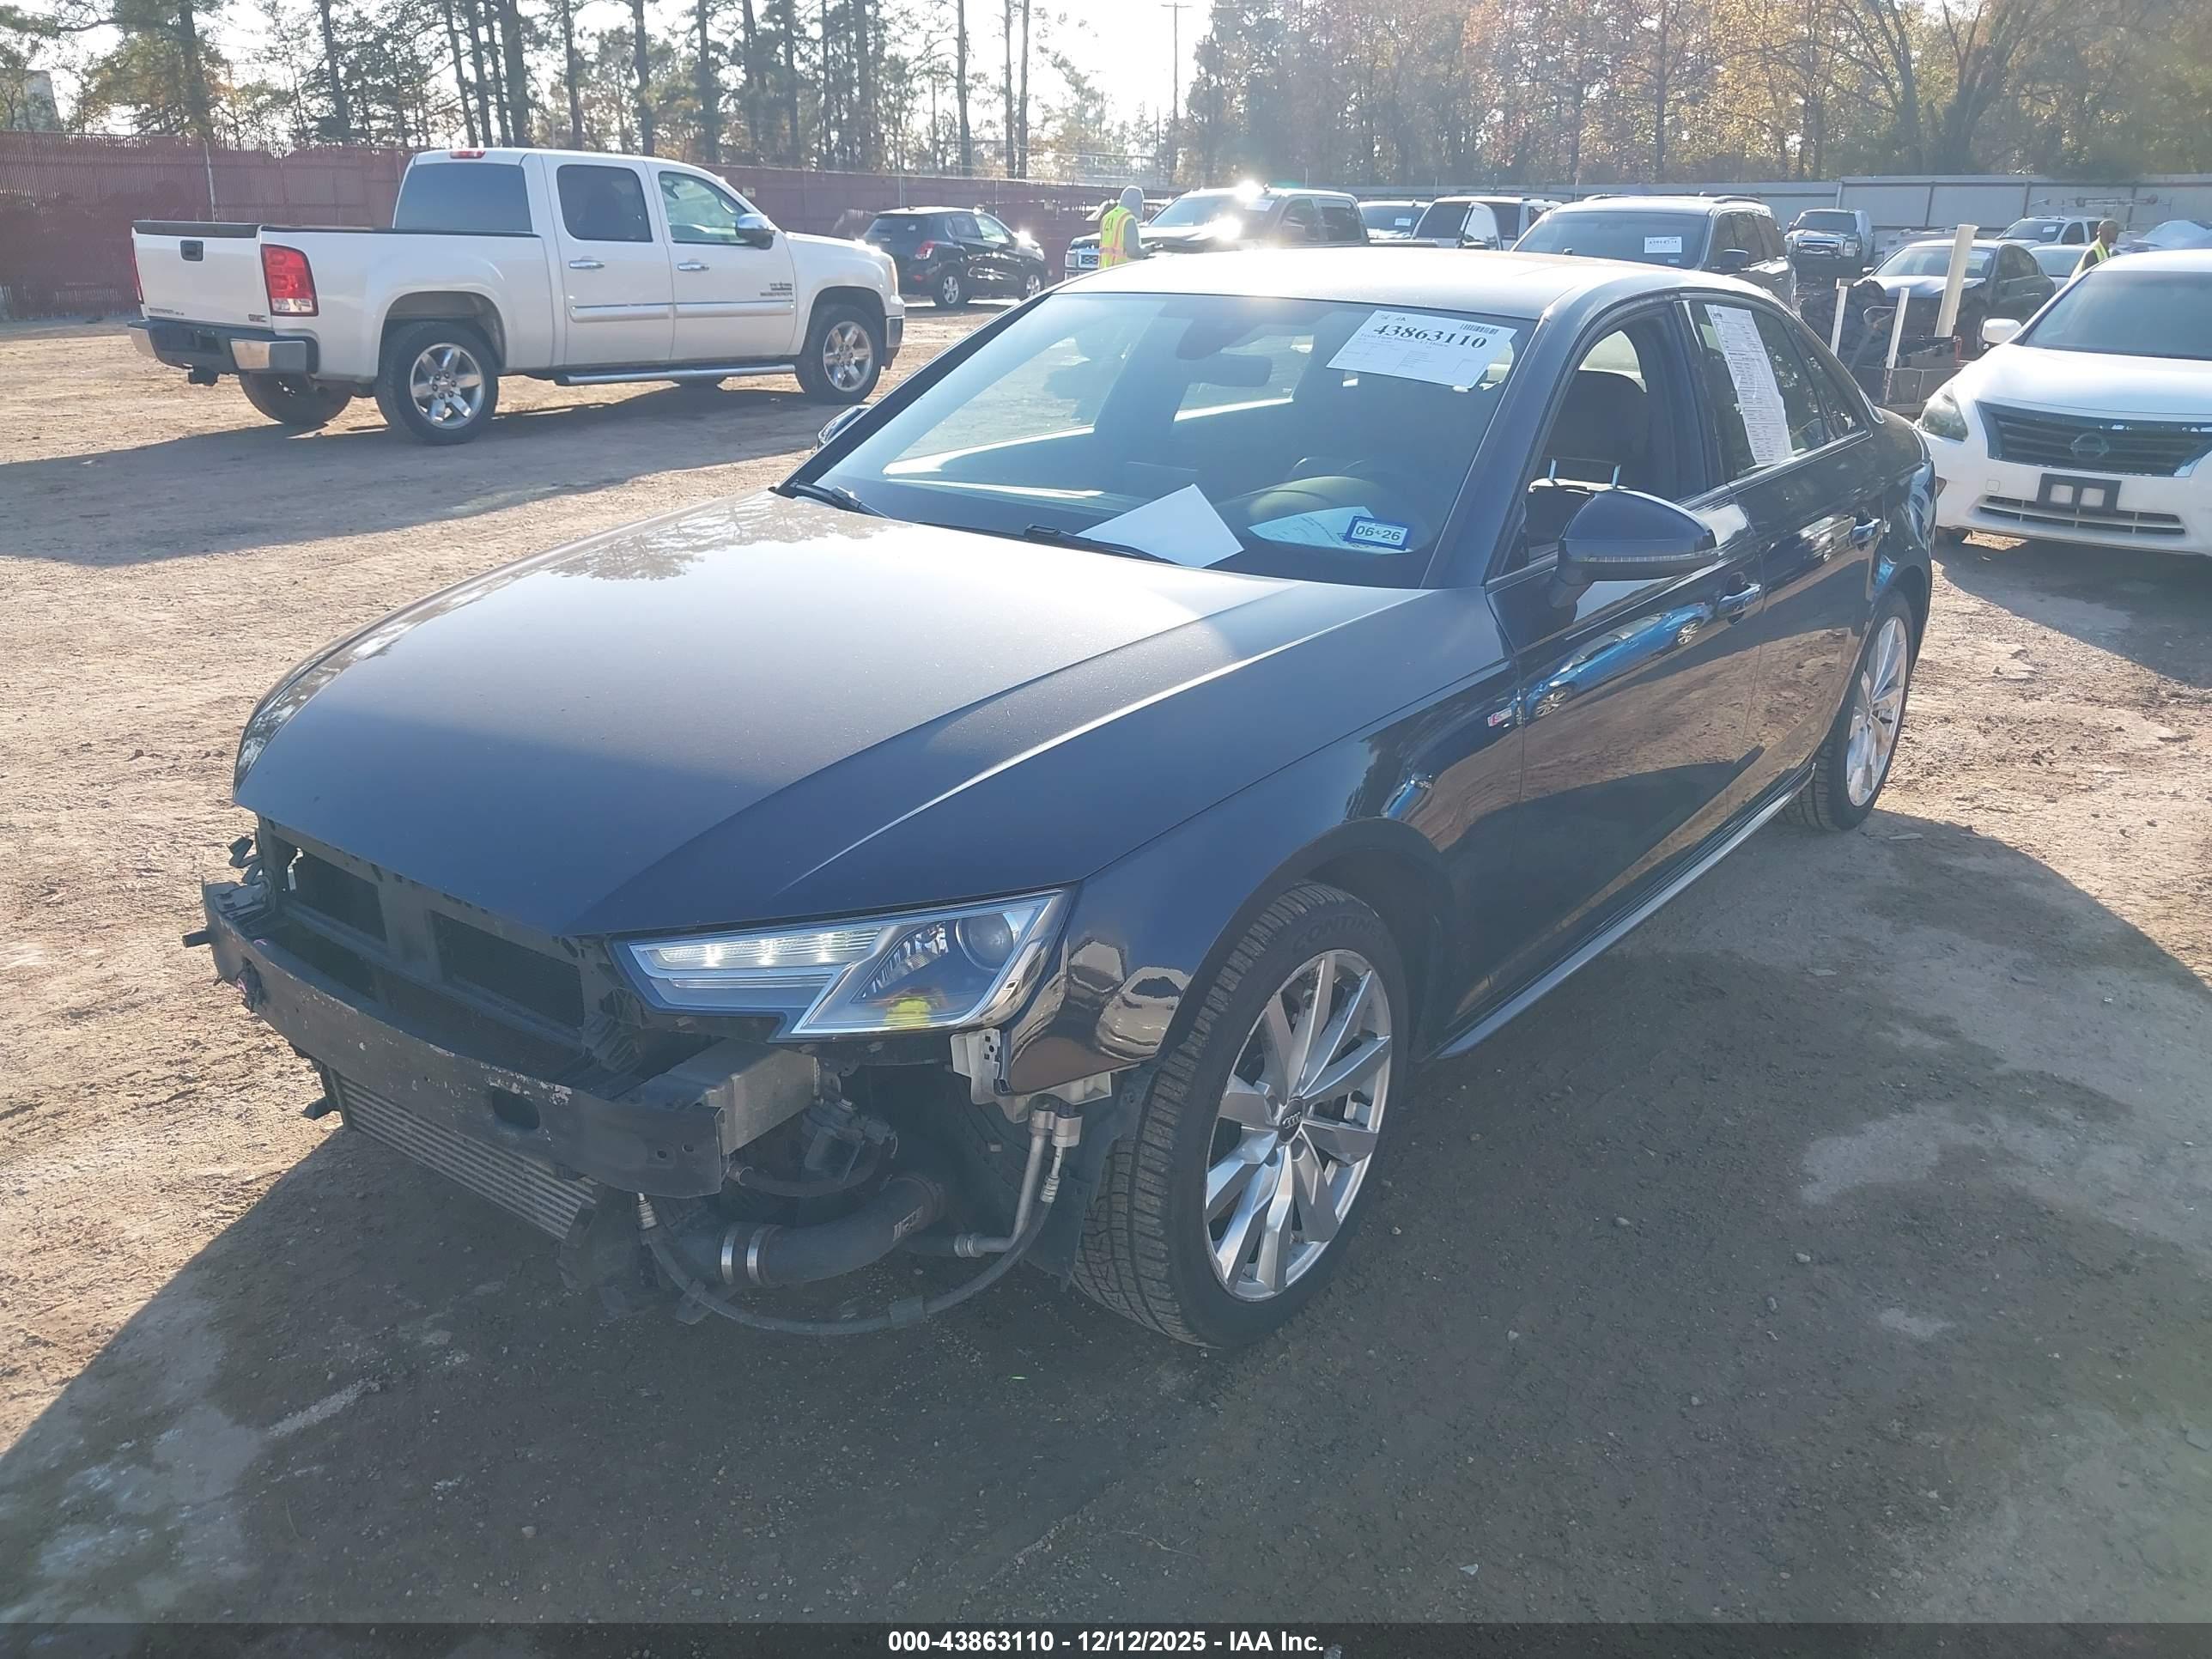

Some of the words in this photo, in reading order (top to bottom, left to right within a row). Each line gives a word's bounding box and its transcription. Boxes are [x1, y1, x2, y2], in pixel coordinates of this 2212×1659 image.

[1373, 324, 1488, 349] 43863110
[1356, 525, 1375, 537] 06
[1382, 530, 1401, 541] 26
